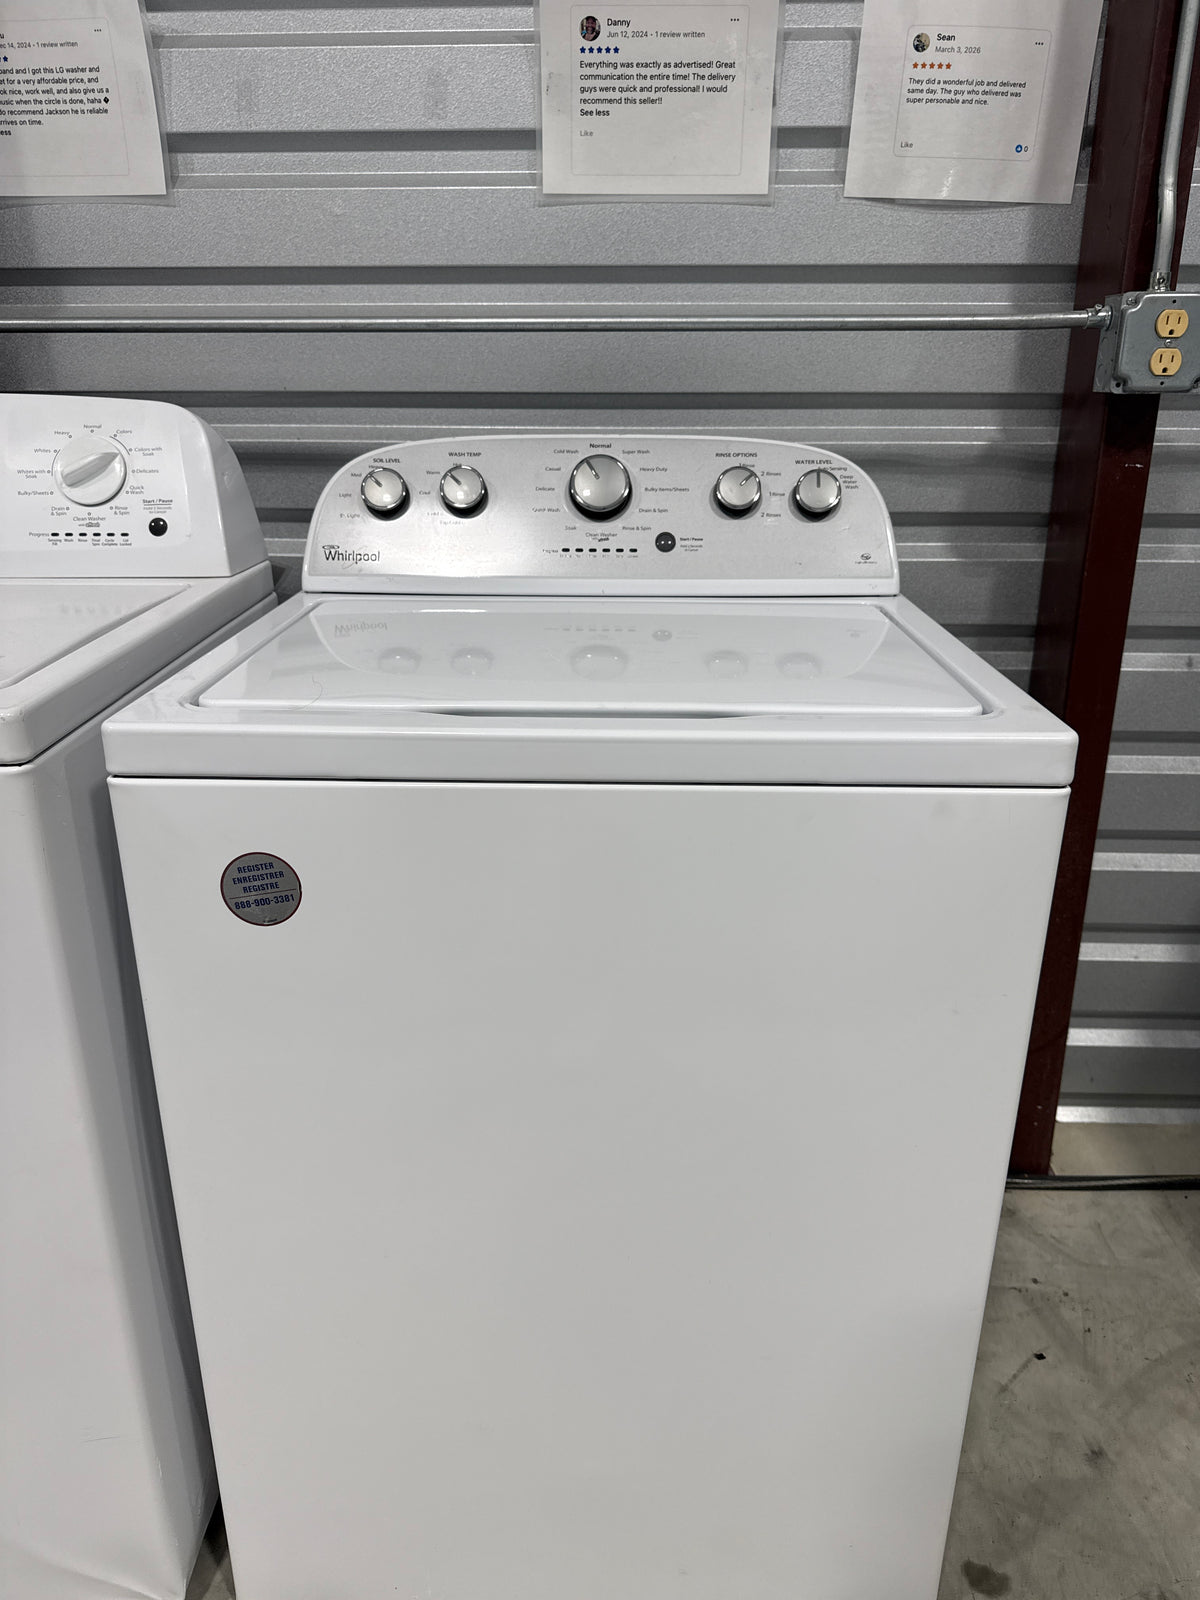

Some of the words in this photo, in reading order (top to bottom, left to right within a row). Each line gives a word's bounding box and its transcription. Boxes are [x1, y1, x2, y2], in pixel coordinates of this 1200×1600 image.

[607, 18, 631, 28] Danny
[620, 31, 629, 39] 12,
[660, 30, 682, 38] review
[683, 30, 705, 38] written
[936, 33, 956, 42] Sean
[7, 42, 16, 50] 14,
[16, 41, 31, 49] 2024
[40, 40, 58, 48] review
[956, 46, 962, 54] 3,
[964, 46, 981, 54] 2026
[42, 66, 54, 74] this
[55, 66, 64, 74] LG
[65, 65, 87, 73] washer
[88, 65, 100, 73] and
[580, 60, 618, 70] Everything
[619, 61, 634, 69] was
[636, 60, 661, 70] exactly
[673, 60, 714, 69] advertised!
[715, 60, 736, 69] Great
[6, 77, 15, 85] for
[69, 77, 86, 85] price,
[579, 73, 635, 81] communication
[636, 73, 648, 81] the
[649, 73, 670, 81] entire
[672, 72, 690, 81] time!
[692, 72, 706, 81] The
[707, 72, 736, 82] delivery
[909, 77, 924, 86] They
[974, 79, 985, 87] job
[999, 80, 1027, 88] delivered
[9, 88, 23, 96] nice,
[41, 87, 55, 95] well,
[82, 87, 95, 95] give
[579, 86, 597, 94] guys
[618, 84, 638, 94] quick
[639, 84, 653, 93] and
[706, 84, 728, 93] would
[925, 87, 939, 96] day.
[940, 87, 952, 95] The
[981, 89, 1009, 97] delivered
[44, 97, 61, 105] circle
[69, 97, 86, 105] done,
[579, 97, 622, 105] recommend
[624, 97, 637, 105] this
[638, 96, 663, 105] seller!!
[7, 108, 44, 116] recommend
[579, 108, 594, 117] See
[595, 108, 610, 117] less
[323, 549, 381, 565] Whirlpool
[237, 862, 275, 874] REGISTER
[232, 870, 285, 885] ENREGISTRER
[242, 881, 280, 894] REGISTRE
[234, 893, 295, 910] 888-900-3381
